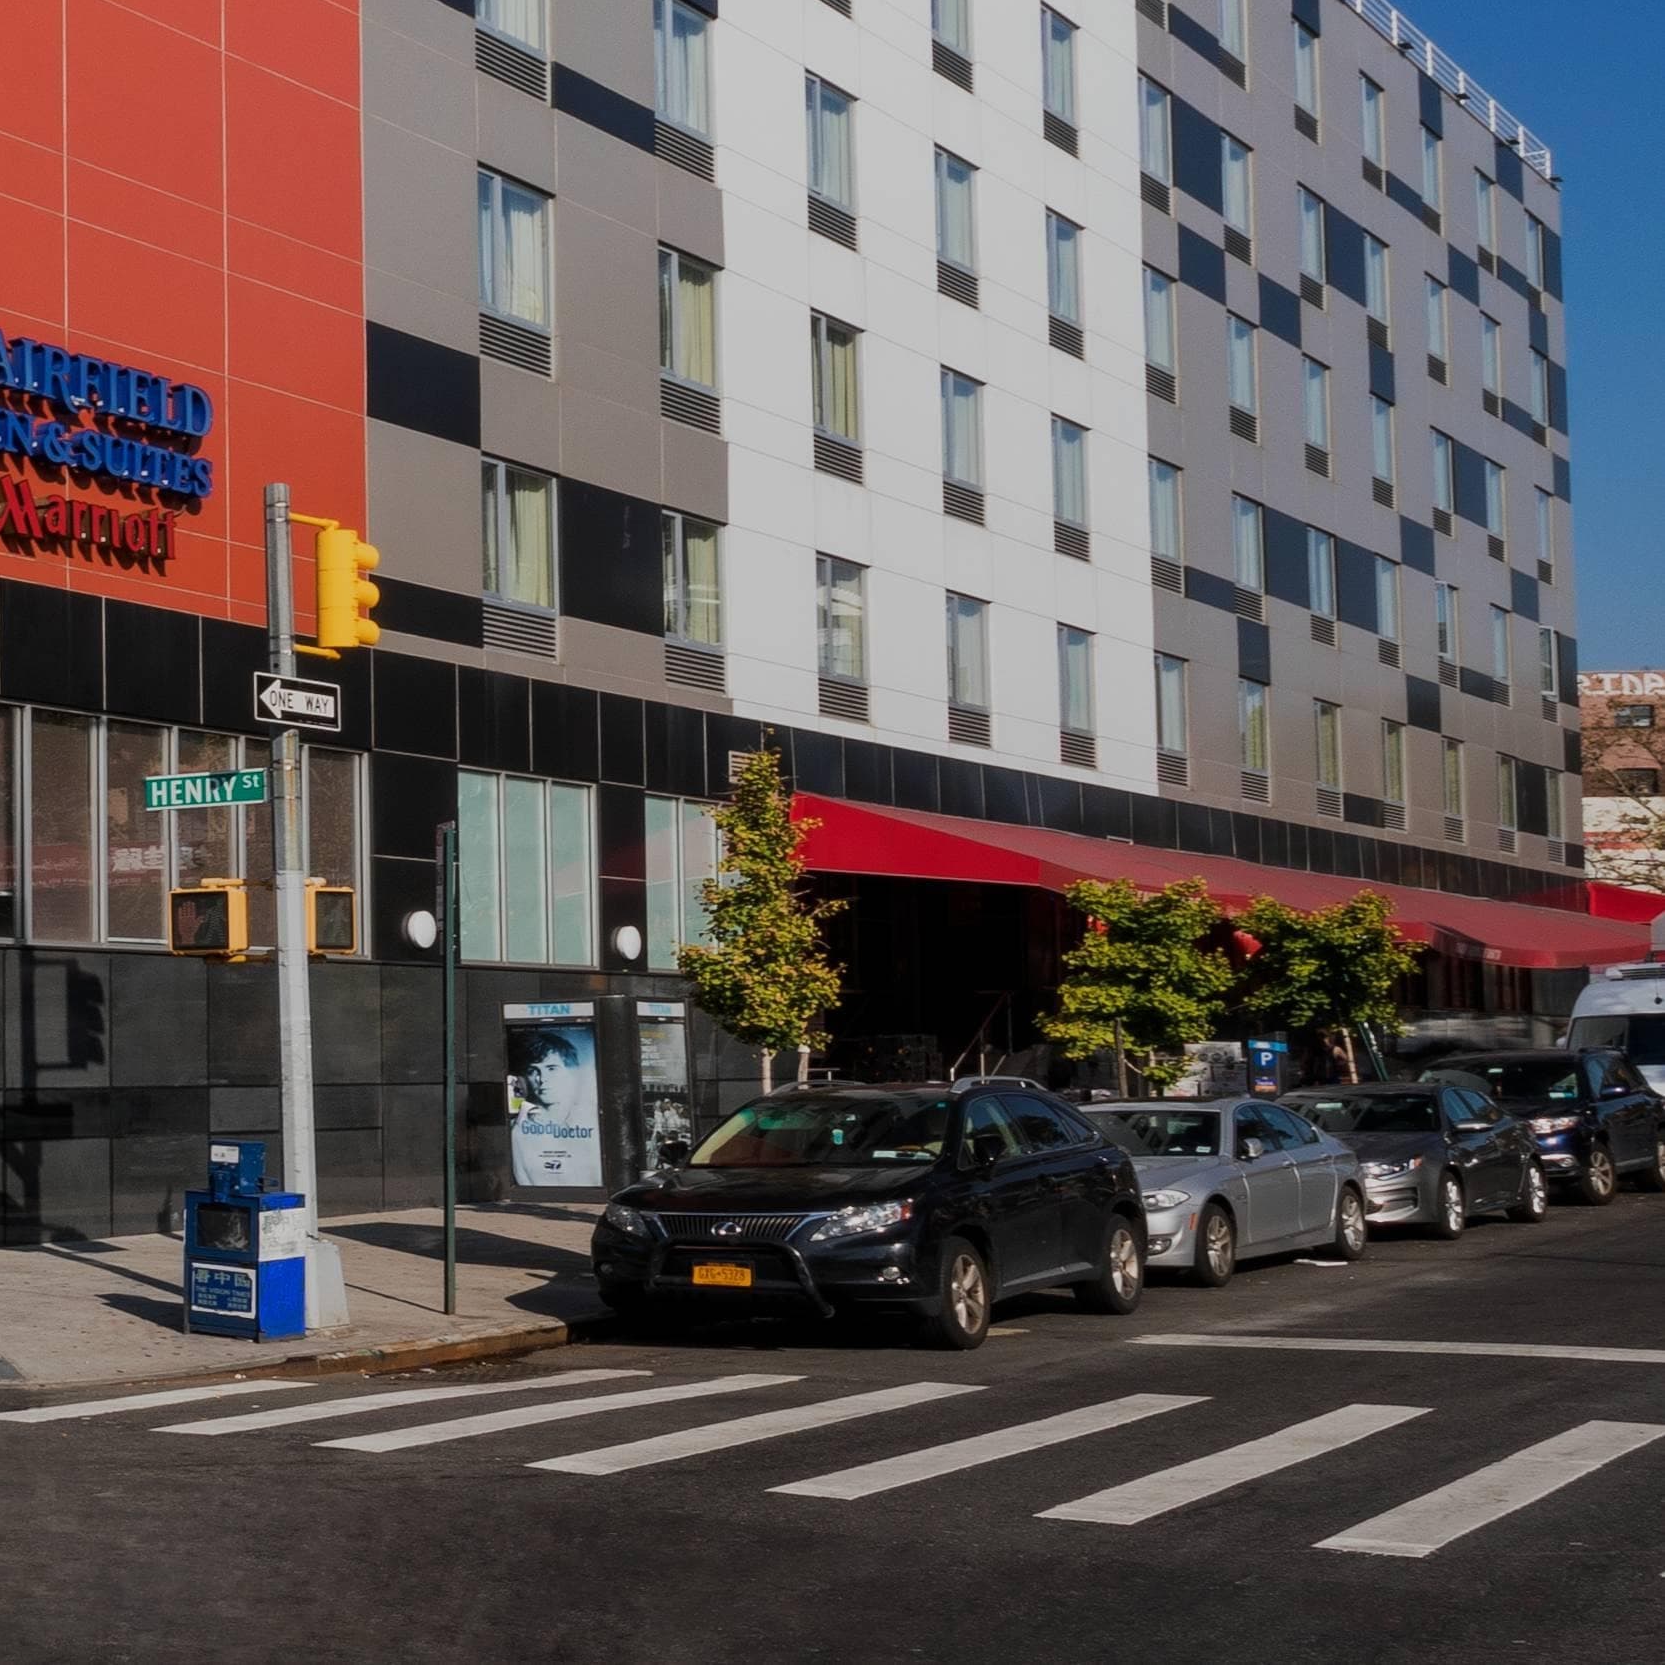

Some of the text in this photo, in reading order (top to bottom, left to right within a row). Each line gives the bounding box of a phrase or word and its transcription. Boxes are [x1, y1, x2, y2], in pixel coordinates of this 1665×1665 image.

[40, 422, 76, 465] &
[77, 429, 214, 498] SUITES
[269, 690, 329, 715] ONE WAY
[151, 774, 260, 807] HENRY St
[528, 1004, 572, 1016] TITAN
[1260, 1052, 1273, 1066] P
[521, 1119, 594, 1139] Good Doctor
